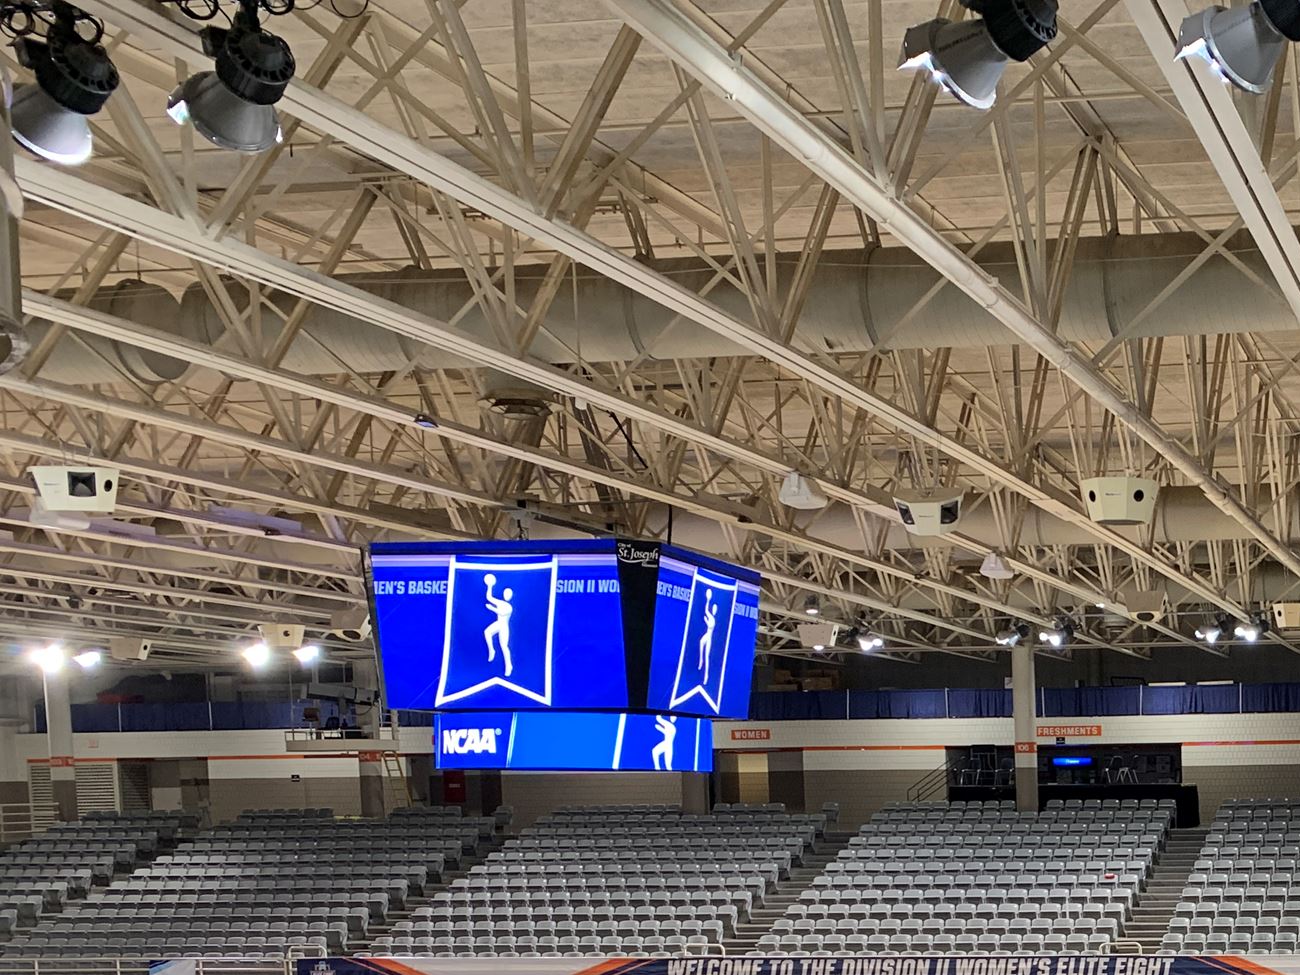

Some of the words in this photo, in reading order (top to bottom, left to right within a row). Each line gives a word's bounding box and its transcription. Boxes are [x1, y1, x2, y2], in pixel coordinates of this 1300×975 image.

[630, 548, 659, 561] Joseph
[734, 731, 768, 739] WOMEN
[1037, 727, 1098, 735] FRESHMENTS
